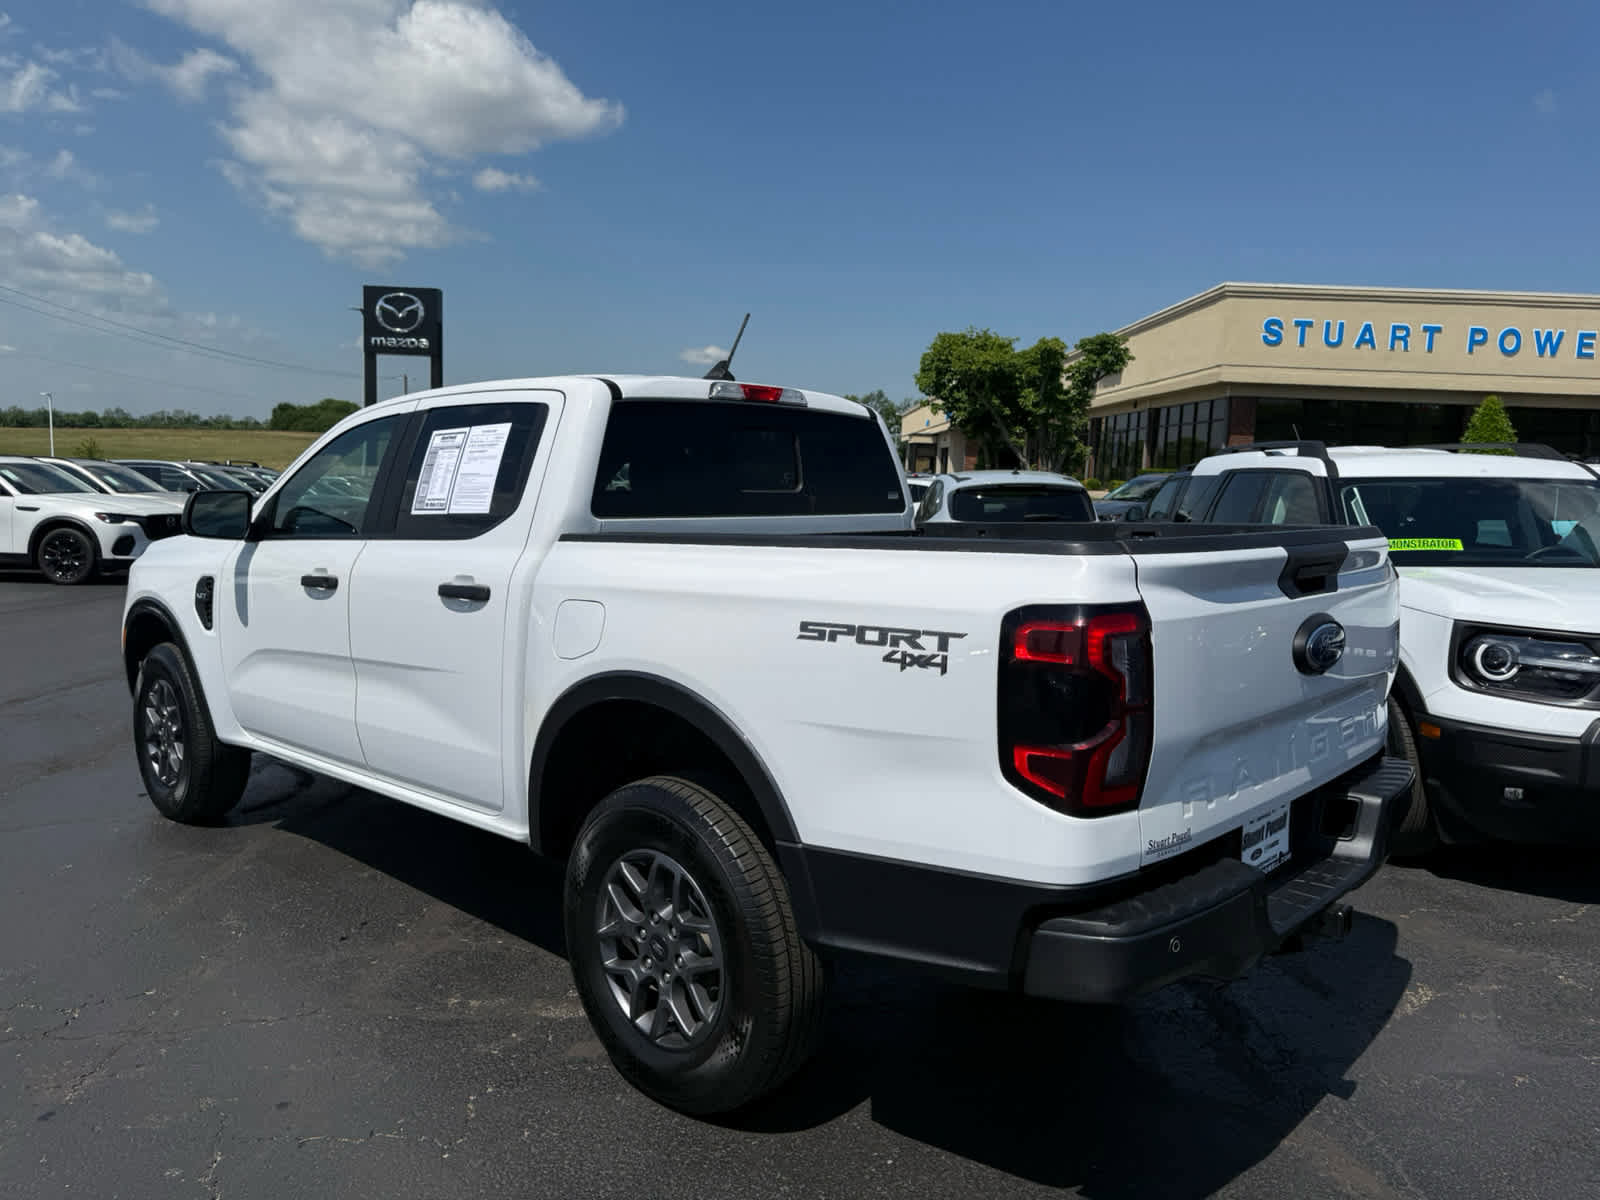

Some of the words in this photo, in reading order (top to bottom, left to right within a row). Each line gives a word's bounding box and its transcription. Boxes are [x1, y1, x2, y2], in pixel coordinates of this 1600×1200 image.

[371, 336, 430, 349] mazda
[1261, 317, 1442, 353] STUART
[1467, 326, 1598, 360] POWE
[797, 621, 968, 652] SPORT
